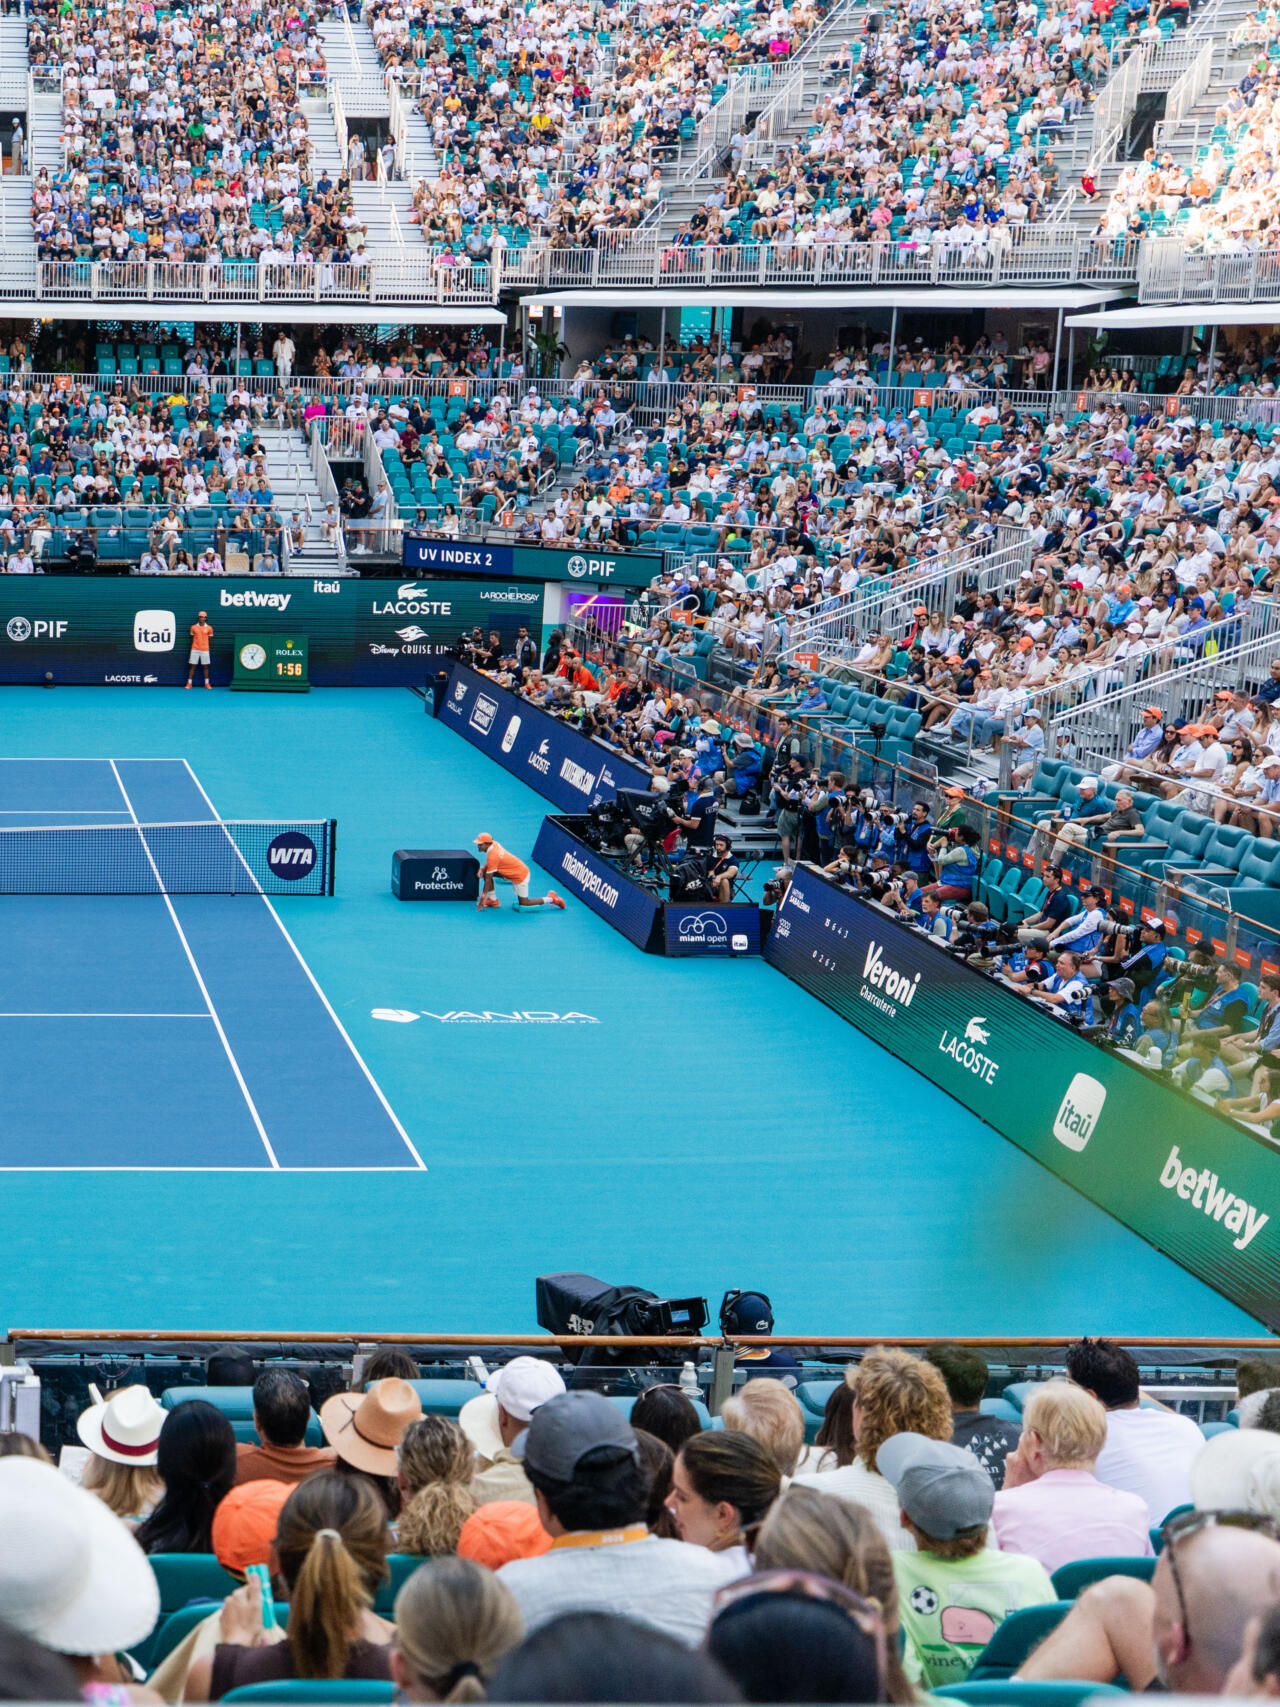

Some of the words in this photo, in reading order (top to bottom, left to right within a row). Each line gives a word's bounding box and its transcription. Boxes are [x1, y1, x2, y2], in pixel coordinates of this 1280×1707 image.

[419, 547, 437, 561] UV
[441, 550, 481, 565] INDEX
[485, 553, 493, 566] 2
[588, 561, 615, 577] PIF
[313, 580, 340, 594] itaú
[220, 589, 292, 612] betway
[372, 602, 452, 615] LACOSTE
[34, 620, 69, 638] PIF
[138, 627, 172, 643] itaú
[369, 643, 399, 656] Disney
[402, 644, 431, 655] CRUISE
[105, 674, 141, 682] LACOSTE
[276, 662, 303, 676] 1:56
[527, 752, 551, 775] LACOSTE
[270, 847, 313, 865] WTA
[415, 881, 464, 890] Protective
[561, 851, 619, 910] miamiopen.com
[679, 934, 706, 942] miami
[707, 935, 727, 945] open
[862, 940, 922, 1008] Veroni
[860, 984, 897, 1018] Charcuterie
[421, 1010, 599, 1020] VANDA
[938, 1030, 999, 1085] LACOSTE
[1058, 1100, 1094, 1140] itaú
[1158, 1144, 1270, 1251] betway
